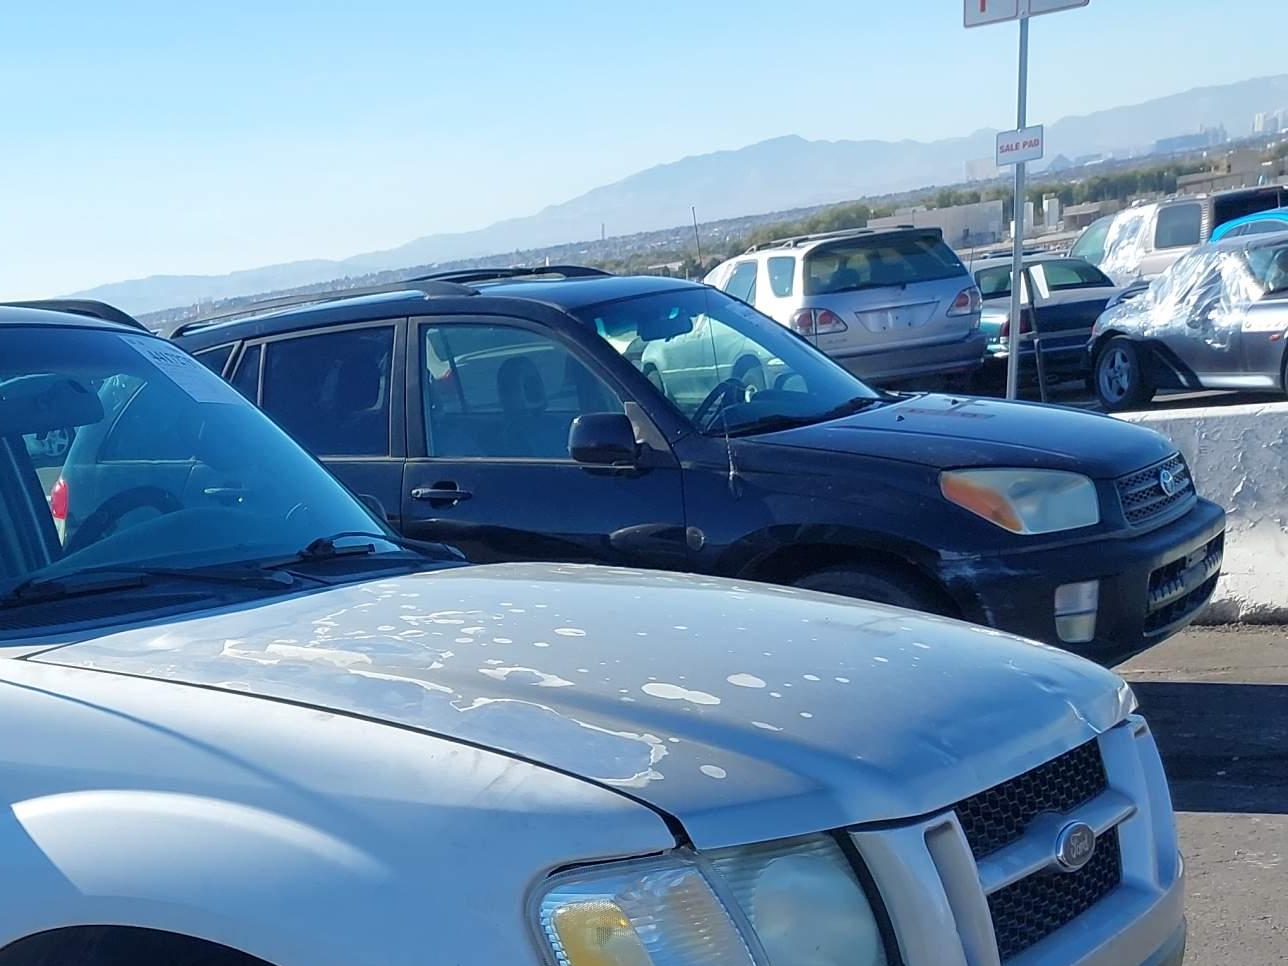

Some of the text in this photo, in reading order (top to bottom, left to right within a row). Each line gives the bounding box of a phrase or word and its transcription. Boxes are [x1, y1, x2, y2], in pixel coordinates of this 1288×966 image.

[999, 138, 1040, 154] SALE PAD
[1069, 830, 1091, 858] Ford
